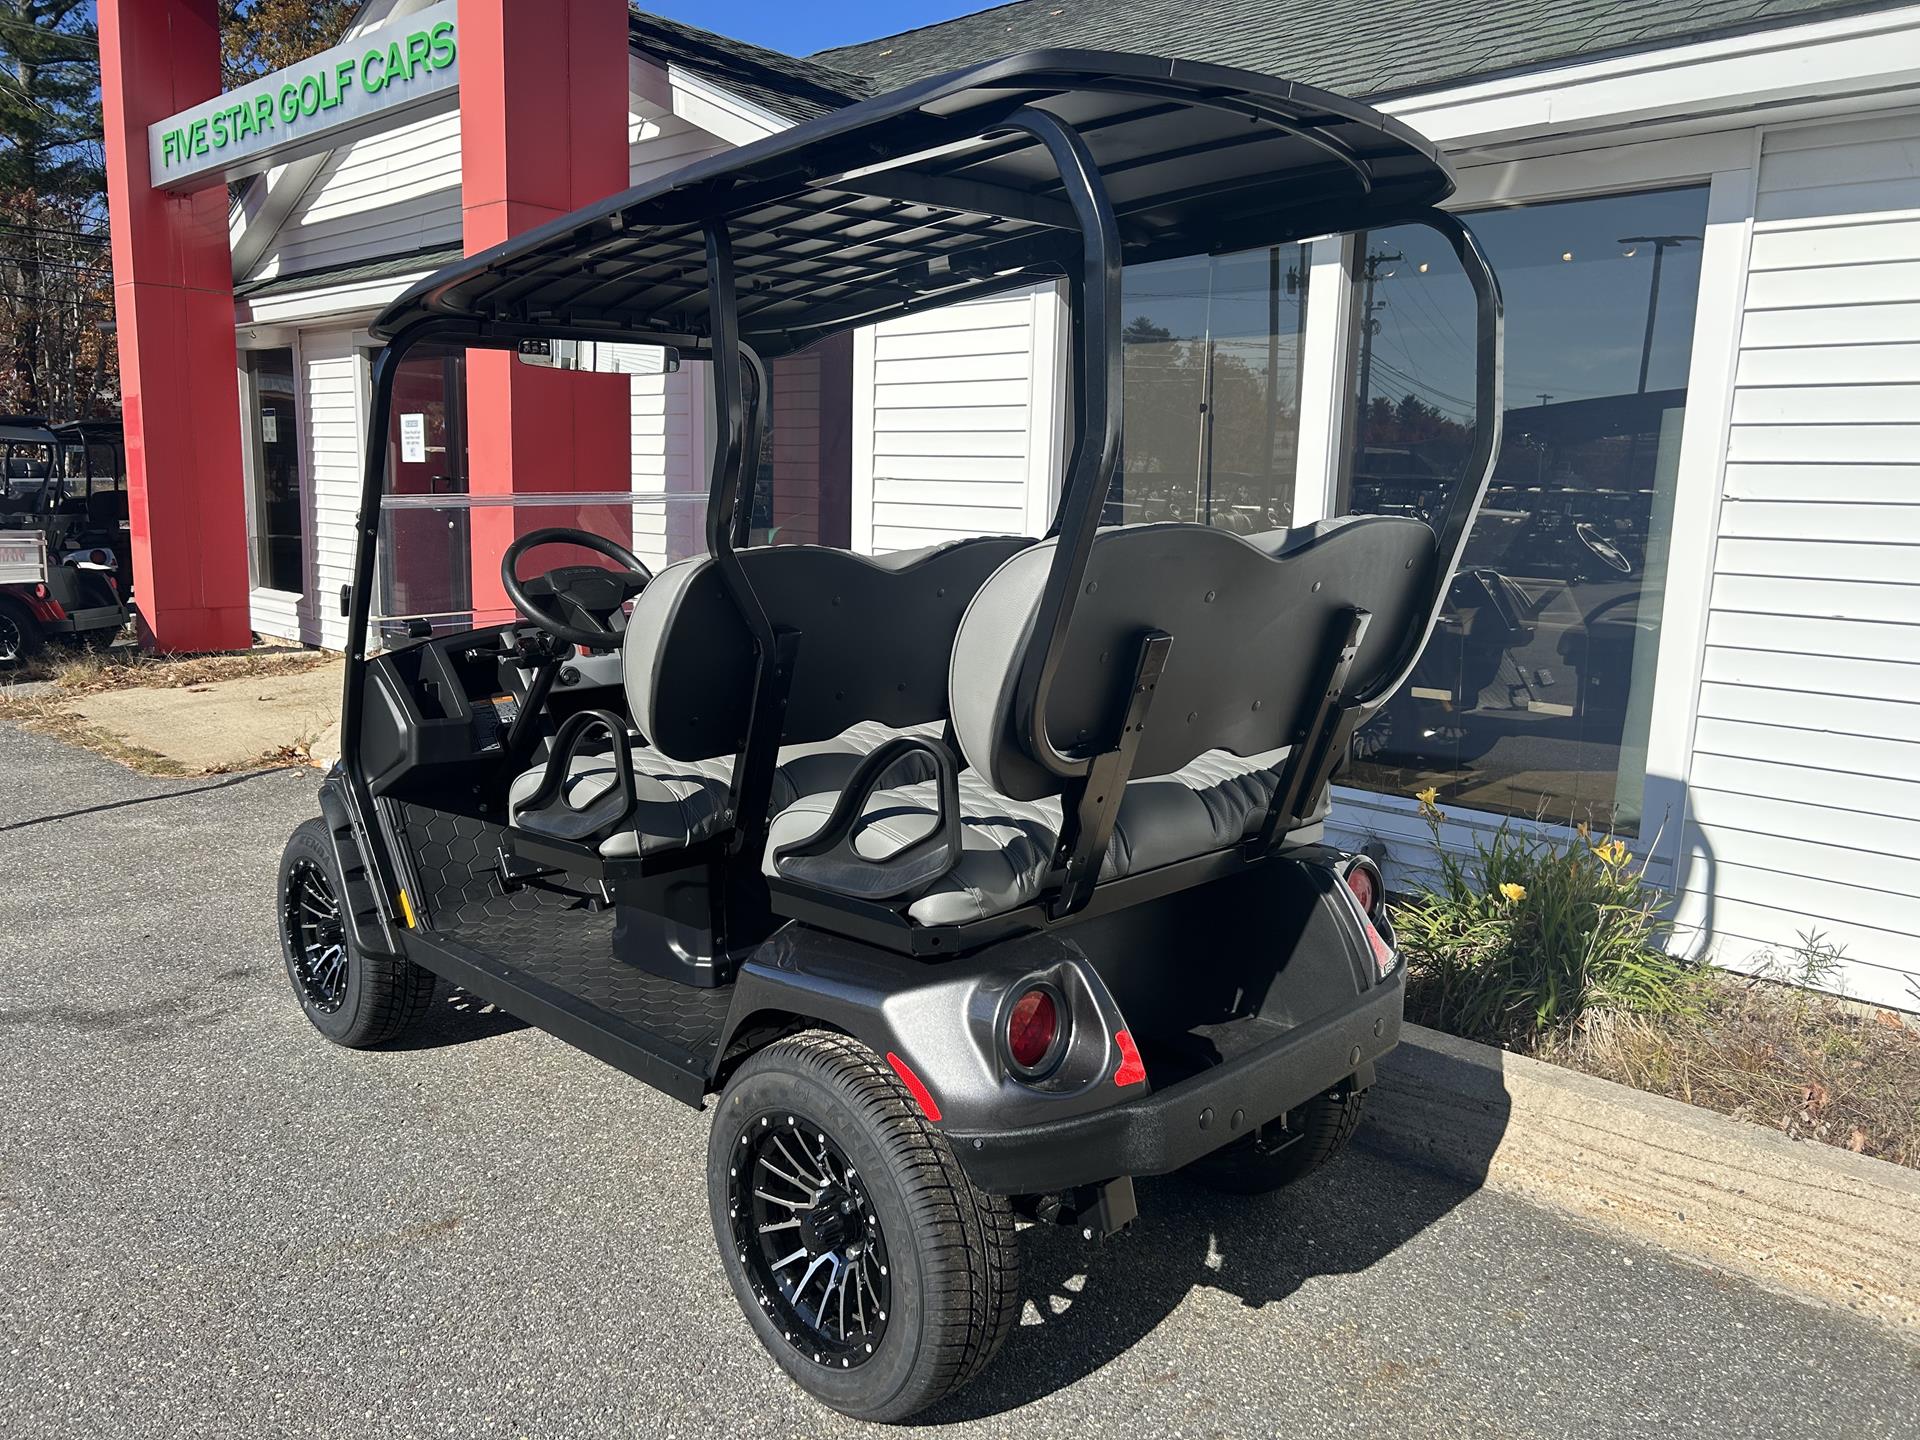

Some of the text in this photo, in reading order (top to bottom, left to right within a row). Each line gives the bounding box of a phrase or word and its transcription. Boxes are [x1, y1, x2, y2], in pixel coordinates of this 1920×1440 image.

[162, 21, 457, 167] FIVE STAR GOLF CARS
